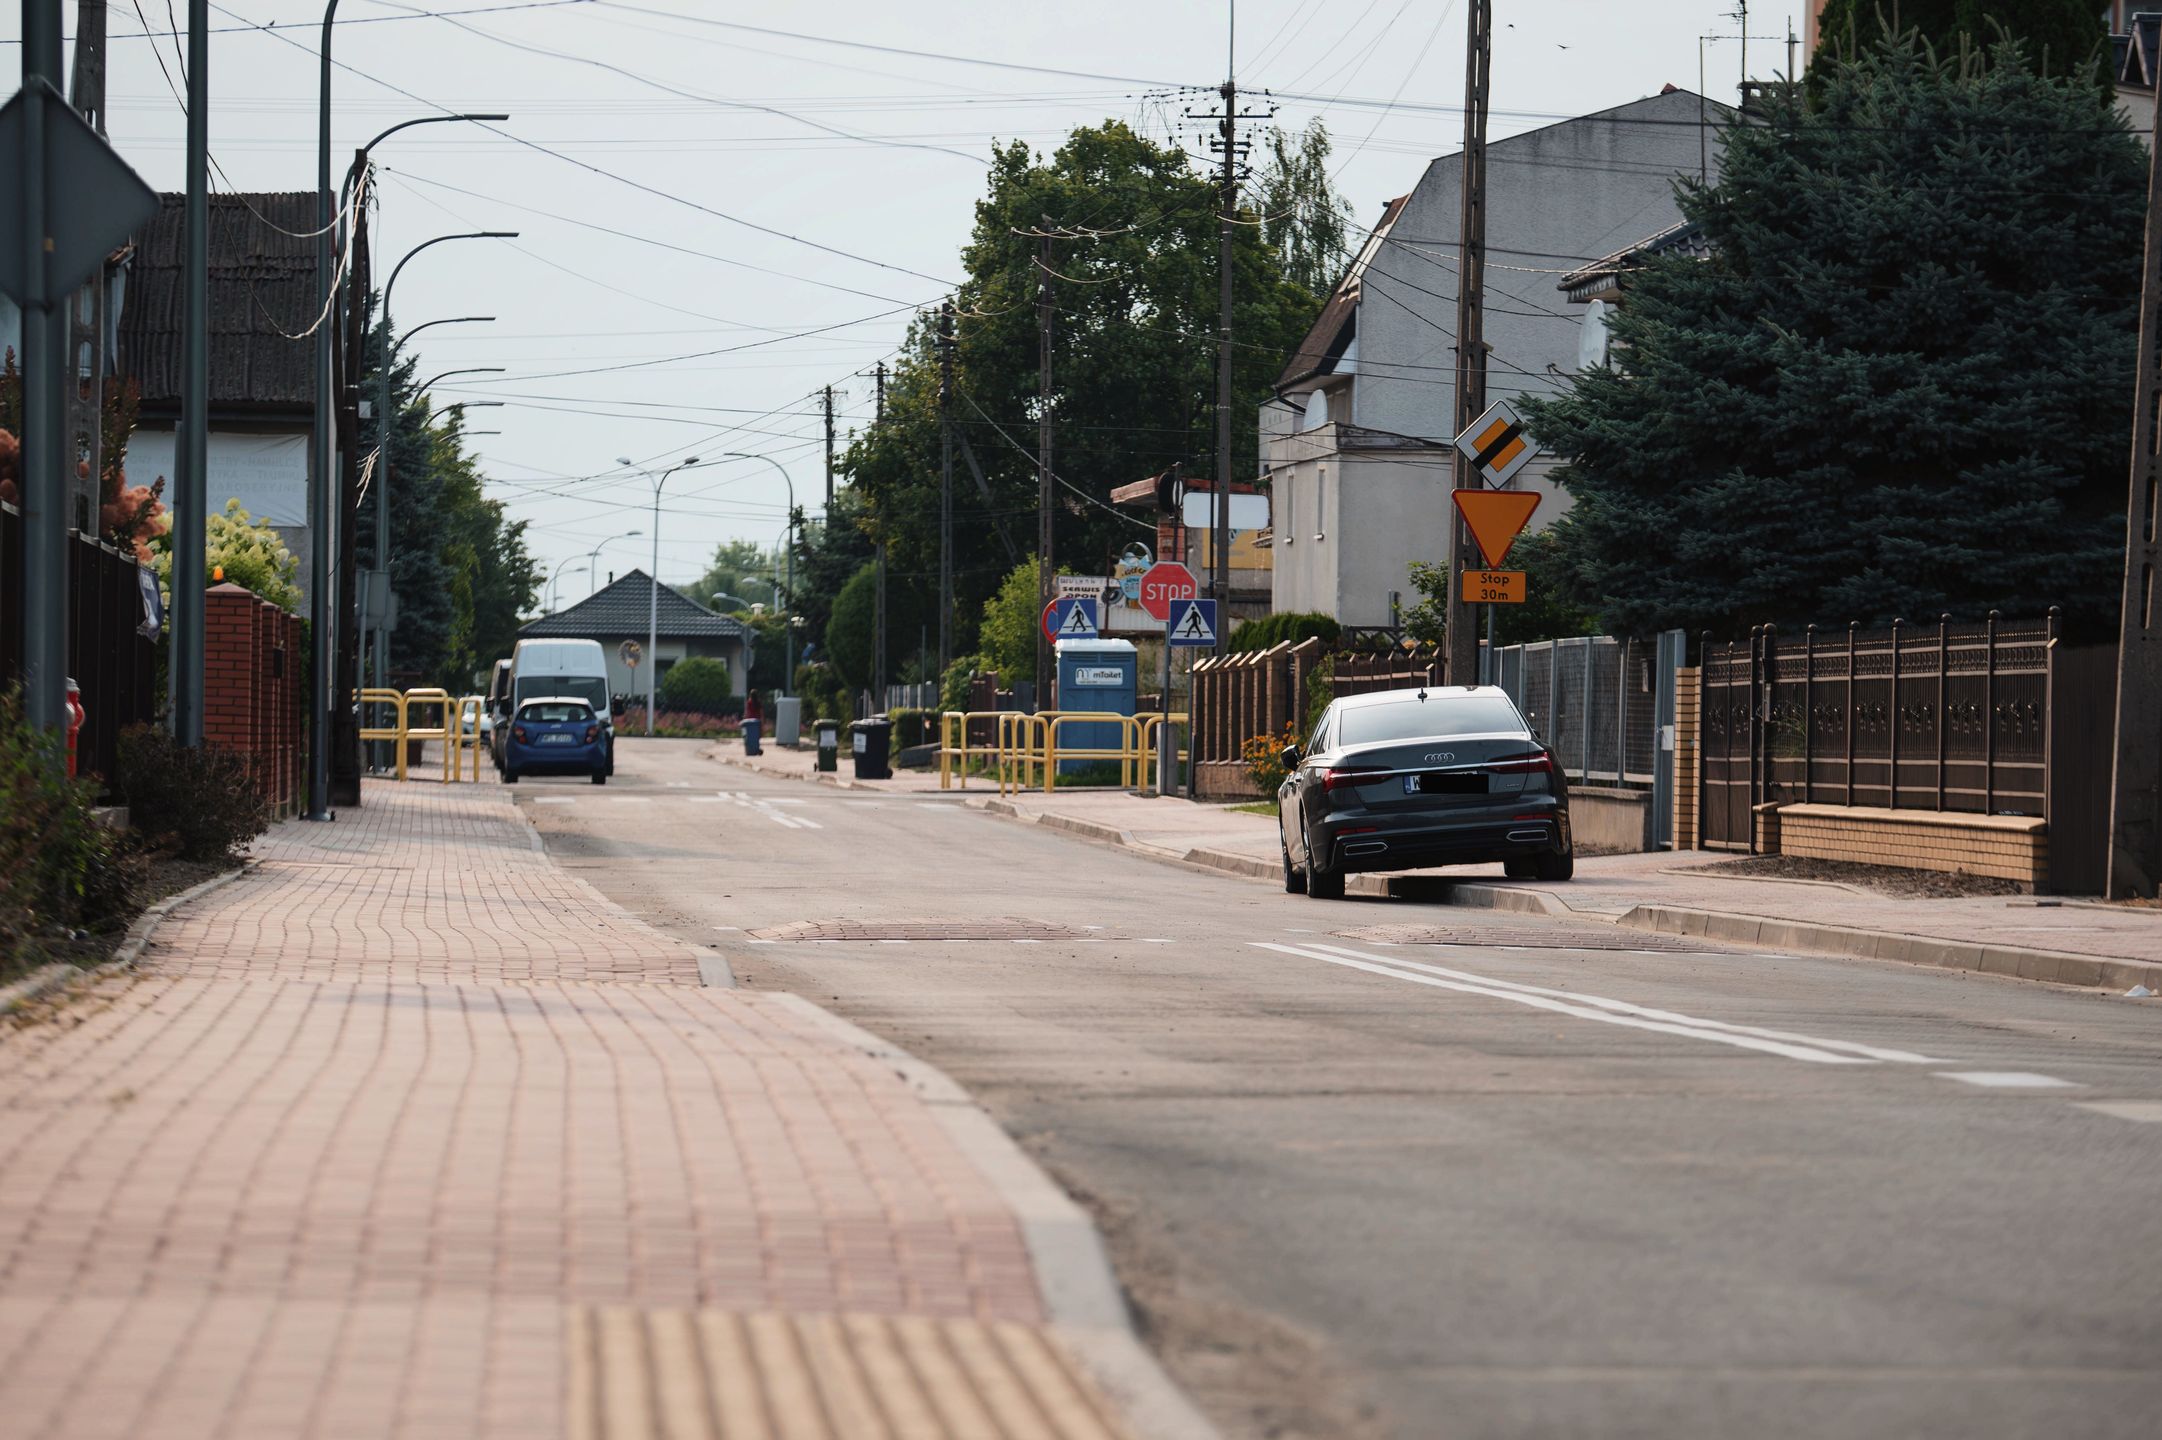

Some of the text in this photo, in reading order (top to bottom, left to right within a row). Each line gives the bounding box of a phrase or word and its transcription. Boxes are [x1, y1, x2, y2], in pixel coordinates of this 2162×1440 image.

[1480, 572, 1510, 587] Stop
[1146, 583, 1192, 600] STOP
[1480, 588, 1509, 600] 30m
[1093, 671, 1122, 679] mToilet
